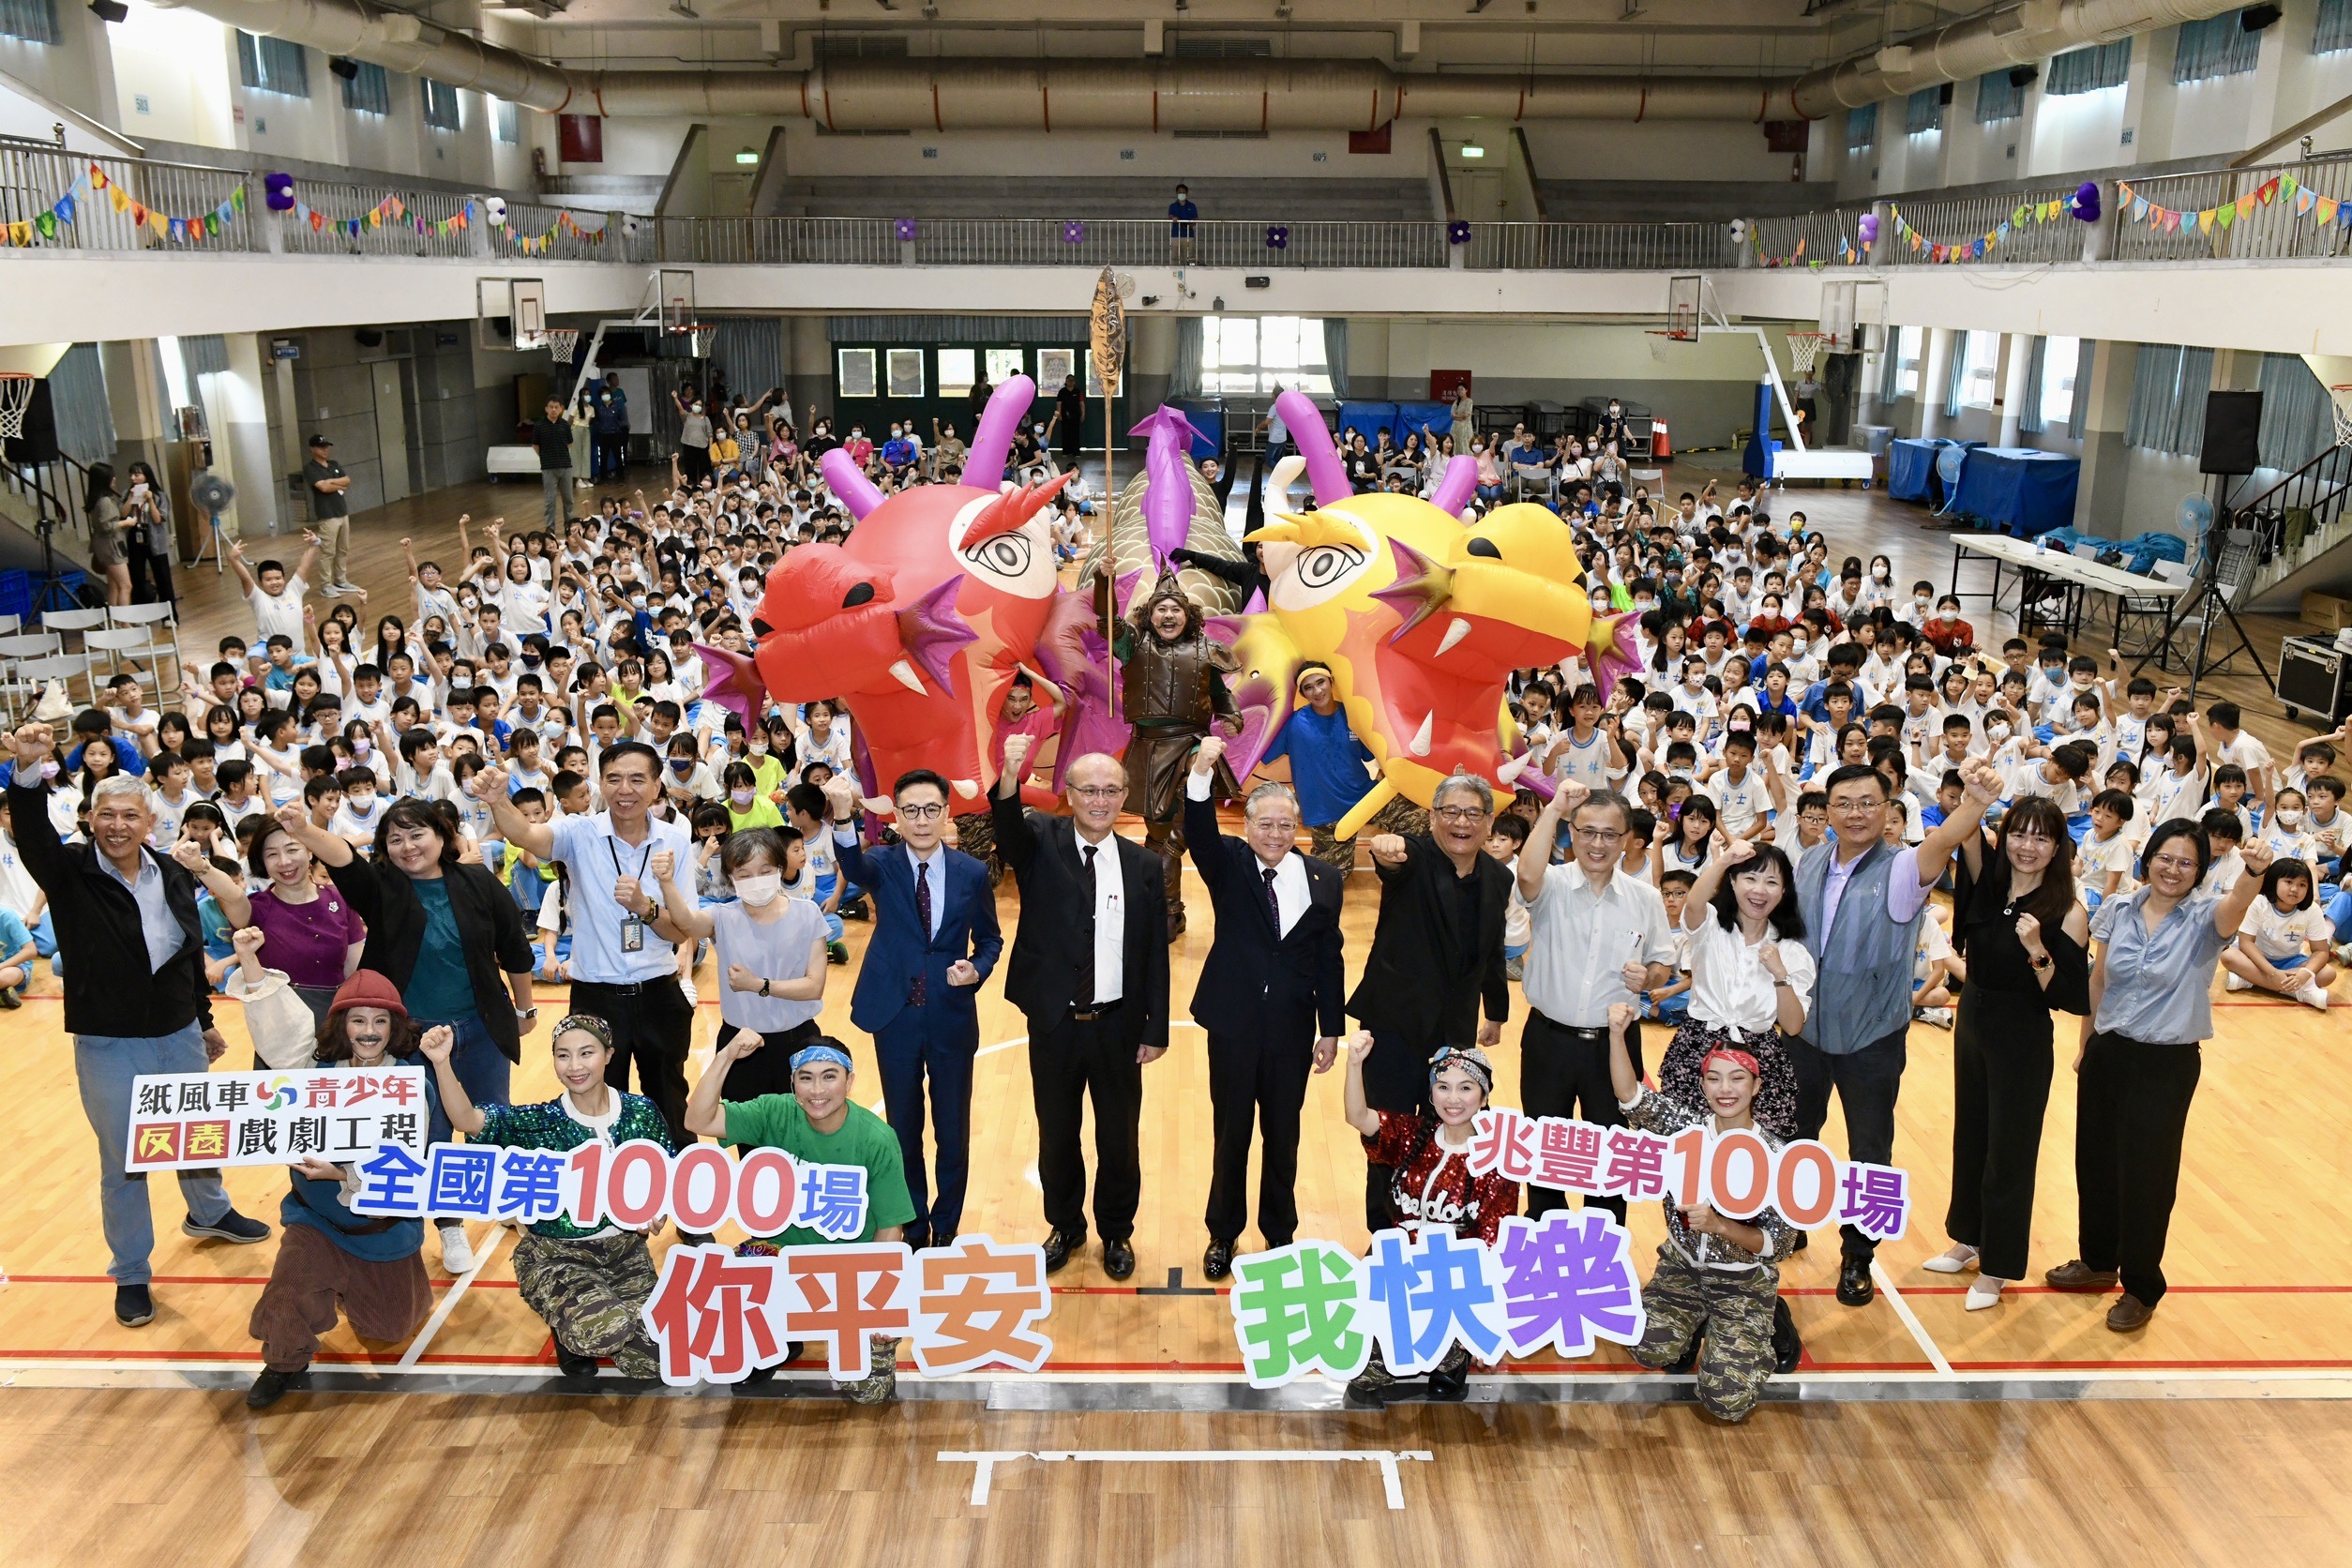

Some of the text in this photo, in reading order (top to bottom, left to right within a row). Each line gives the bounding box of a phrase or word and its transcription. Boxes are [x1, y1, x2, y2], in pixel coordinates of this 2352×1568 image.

[923, 149, 938, 158] 607
[2044, 695, 2058, 705] 士
[2125, 732, 2138, 743] 士
[1563, 761, 1597, 775] 士林
[161, 819, 174, 831] 士
[811, 855, 823, 868] 林
[137, 1073, 418, 1115] 紙風車 青少年
[139, 1113, 418, 1158] 反毒戲劇工程
[1472, 1112, 1905, 1234] 兆豐第100場
[357, 1143, 863, 1234] 全國第1000場
[651, 1244, 1042, 1377] 你平安
[1240, 1216, 1636, 1379] 我快樂
